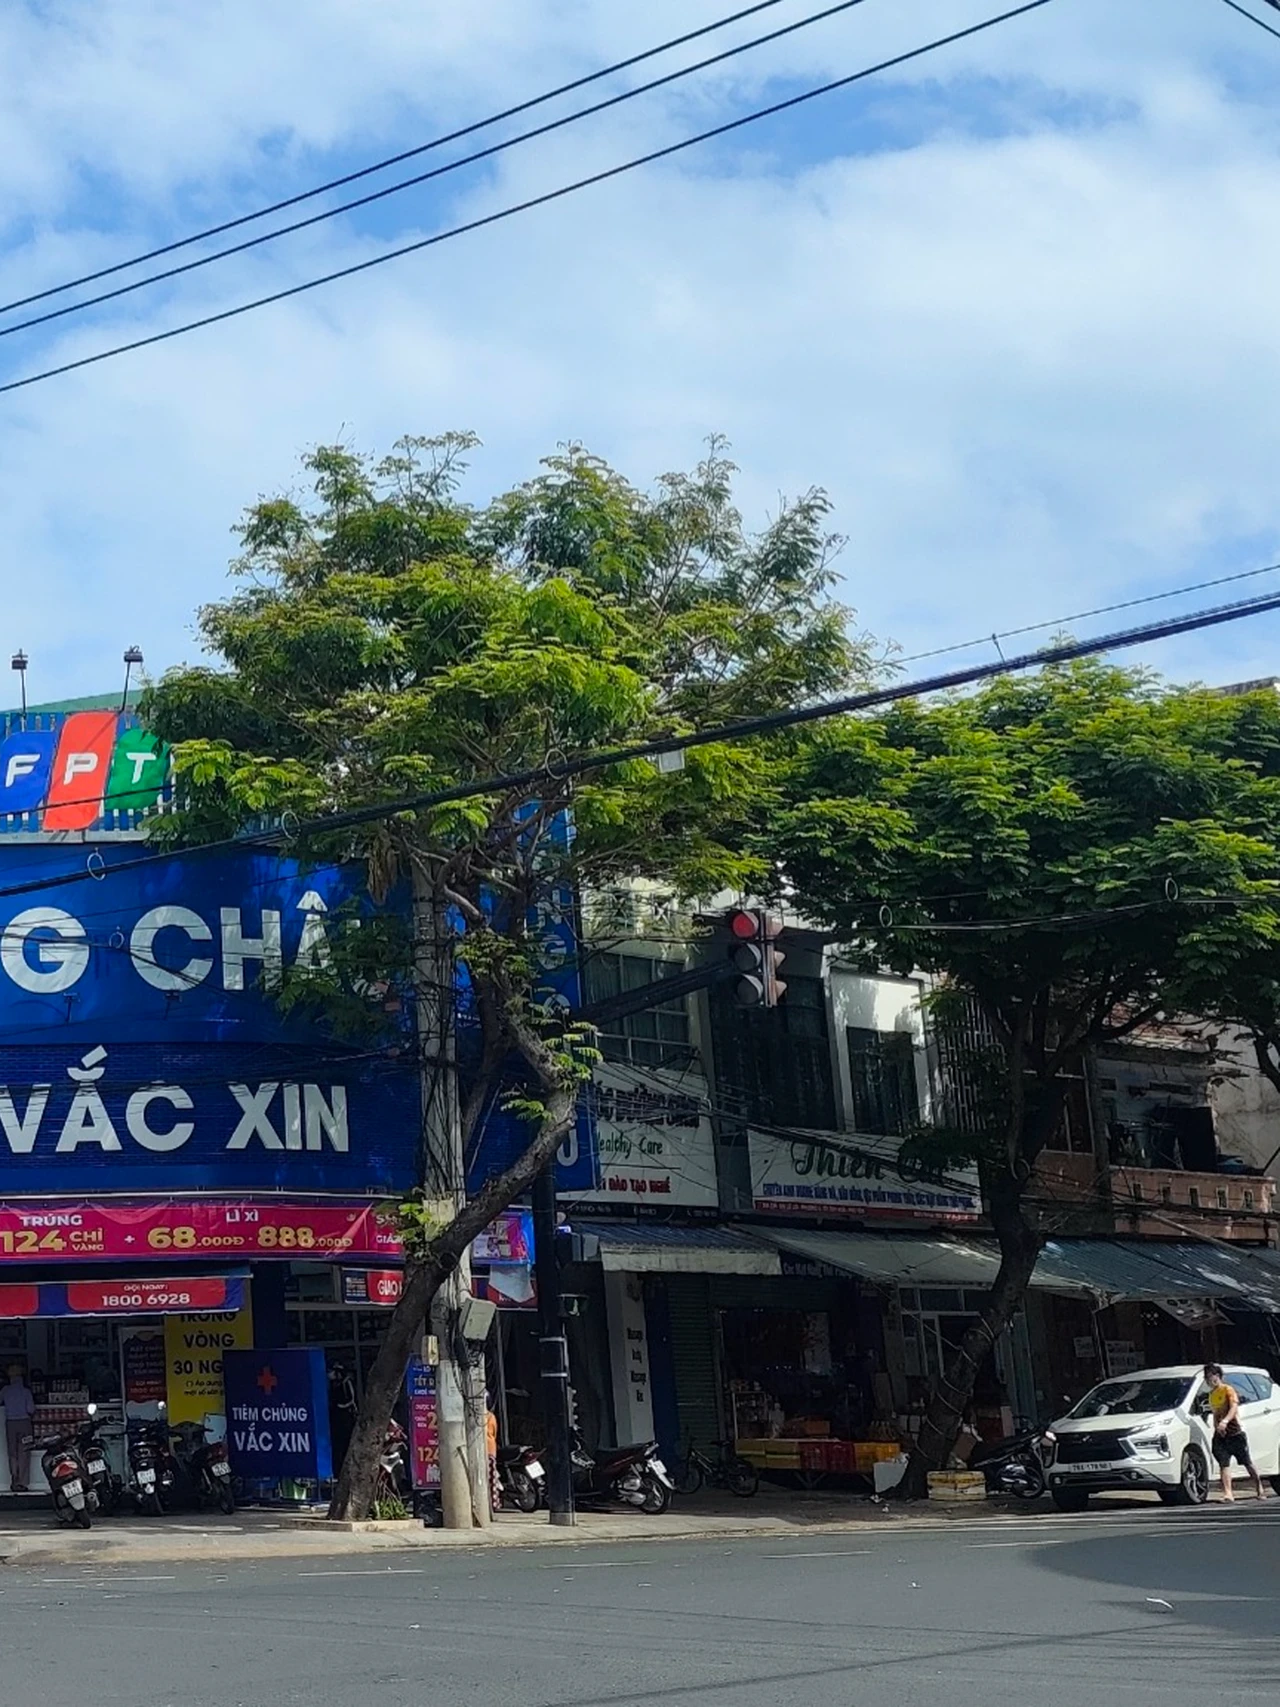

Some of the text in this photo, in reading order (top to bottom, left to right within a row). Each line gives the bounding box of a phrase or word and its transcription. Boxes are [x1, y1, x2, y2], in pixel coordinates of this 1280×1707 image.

[5, 753, 157, 786] FPT
[130, 890, 360, 992] CHÂ
[226, 1082, 349, 1153] XIN
[597, 1132, 631, 1159] ealthy
[19, 1213, 83, 1226] TRÚNG
[72, 1243, 104, 1251] VÀNG
[102, 1293, 190, 1306] 1800 6928
[183, 1330, 234, 1347] VÒNG
[174, 1359, 193, 1374] 30
[199, 1359, 224, 1374] NG
[232, 1402, 308, 1422] TIÊM CHỦNG
[233, 1422, 310, 1453] VẮC XIN
